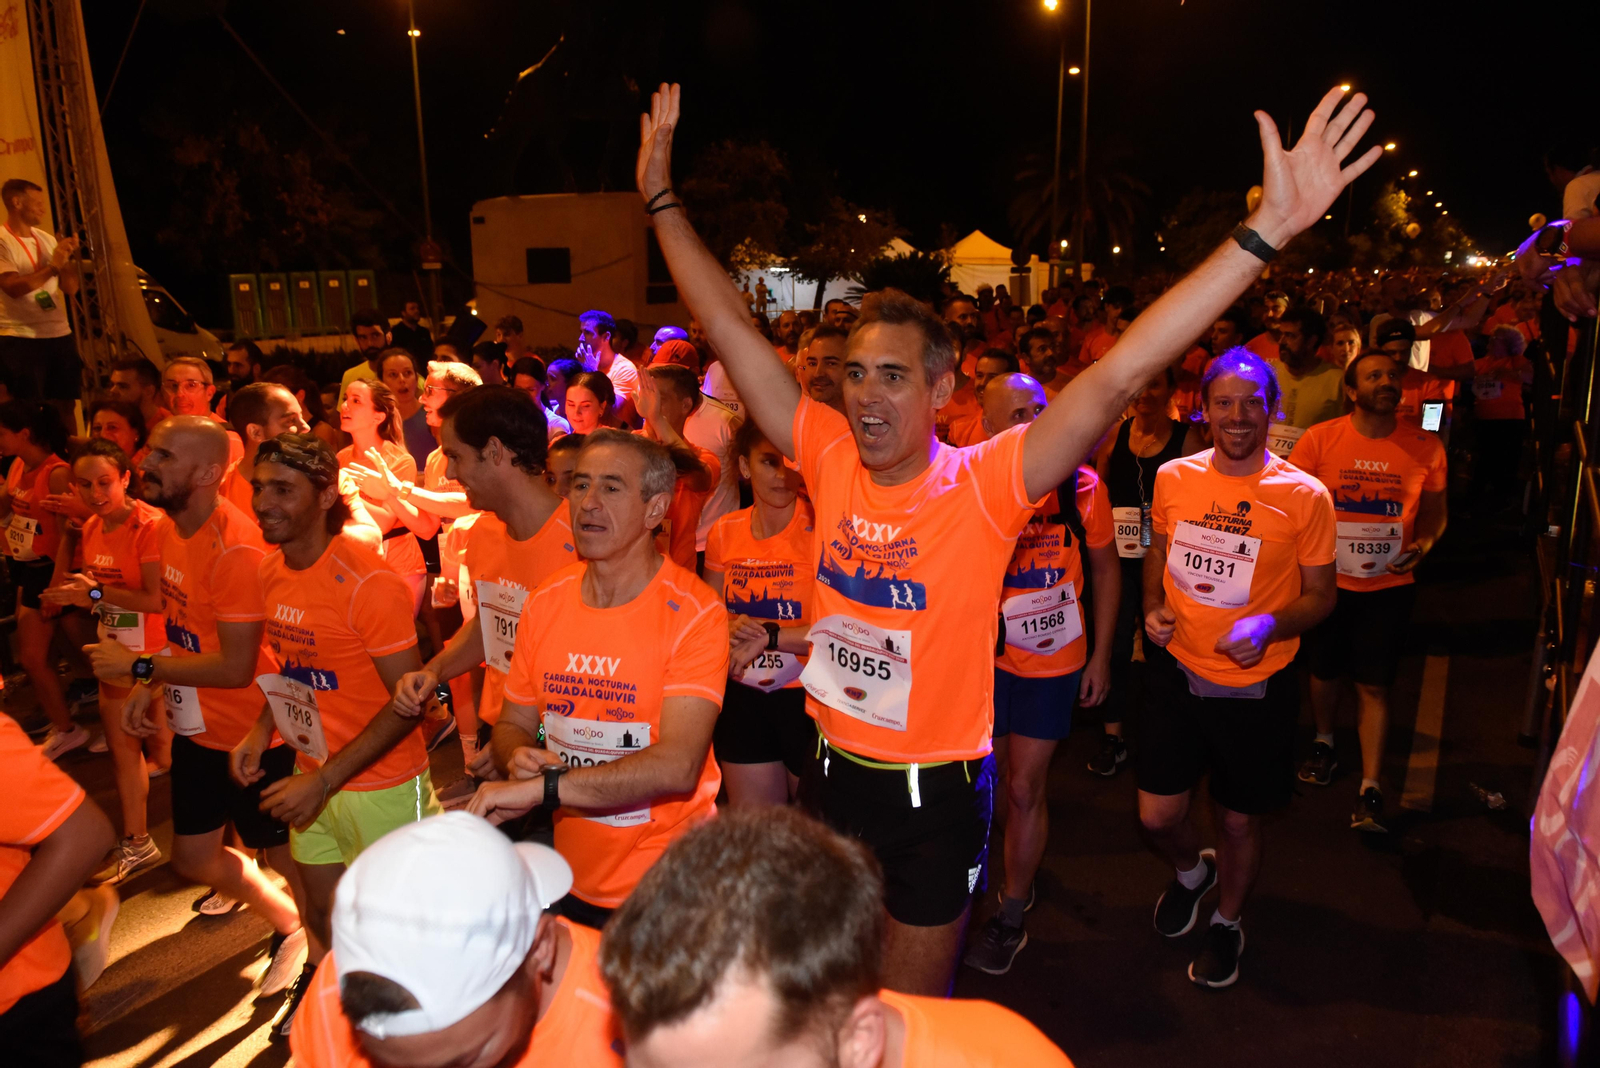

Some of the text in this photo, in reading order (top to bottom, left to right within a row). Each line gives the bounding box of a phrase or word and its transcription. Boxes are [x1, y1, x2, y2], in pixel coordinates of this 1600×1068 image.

[1354, 459, 1389, 471] XXXV
[853, 513, 902, 542] XXXV
[1203, 513, 1253, 527] NOCTURNA
[1348, 542, 1391, 554] 18339
[1184, 551, 1236, 578] 10131
[274, 603, 305, 625] XXXV
[1021, 611, 1065, 635] 11568
[565, 652, 621, 677] XXXV
[828, 642, 892, 681] 16955
[543, 672, 637, 692] CARRERA NOCTURNA
[548, 683, 636, 704] GUADALQUIVIR
[285, 701, 313, 728] 7918
